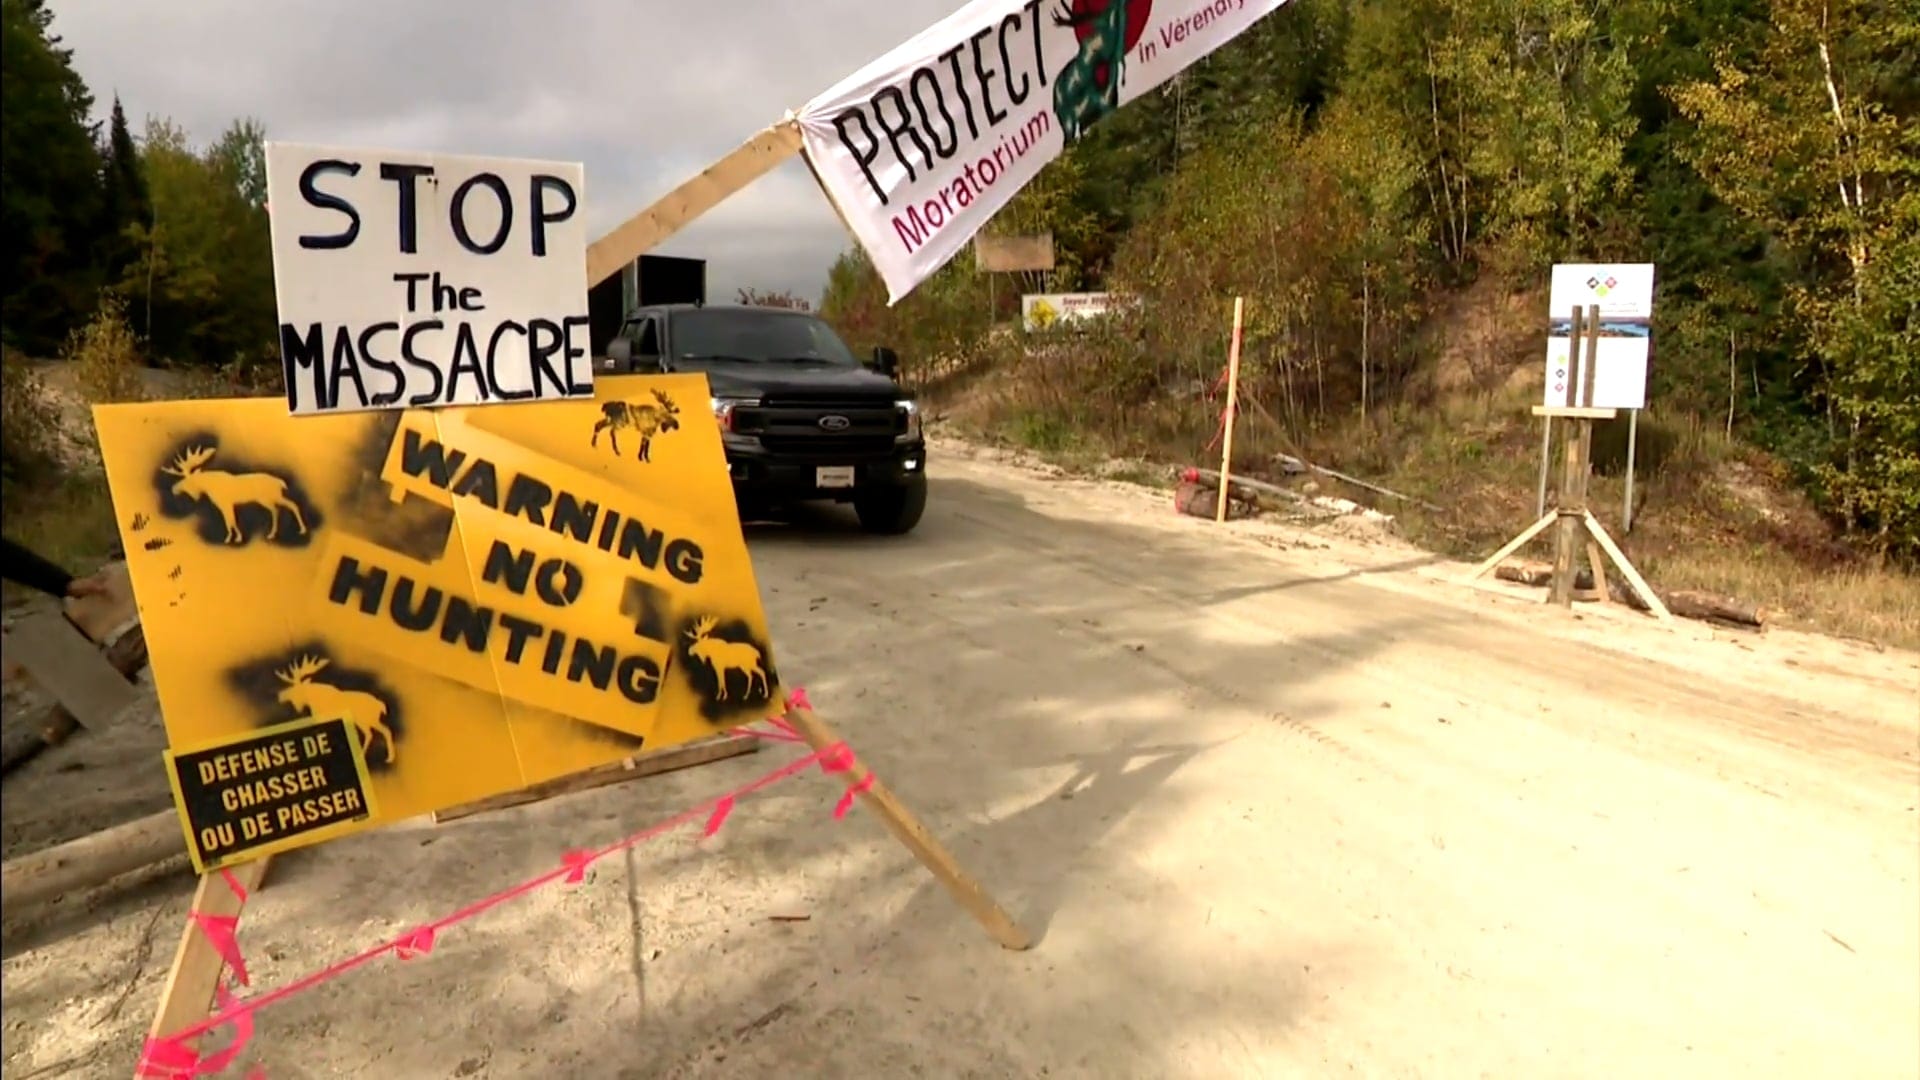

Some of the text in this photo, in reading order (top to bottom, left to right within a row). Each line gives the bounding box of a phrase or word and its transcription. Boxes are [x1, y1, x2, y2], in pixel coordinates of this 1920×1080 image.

[832, 0, 1047, 205] PROTECT
[299, 159, 577, 256] STOP
[891, 110, 1050, 254] Moratorium
[393, 272, 485, 312] The
[281, 316, 594, 412] MASSACRE
[401, 428, 704, 583] WARNING
[482, 539, 583, 607] NO
[328, 555, 660, 704] HUNTING
[221, 765, 328, 812] CHASSER
[302, 732, 332, 758] DE
[200, 788, 361, 852] OU DE PASSER
